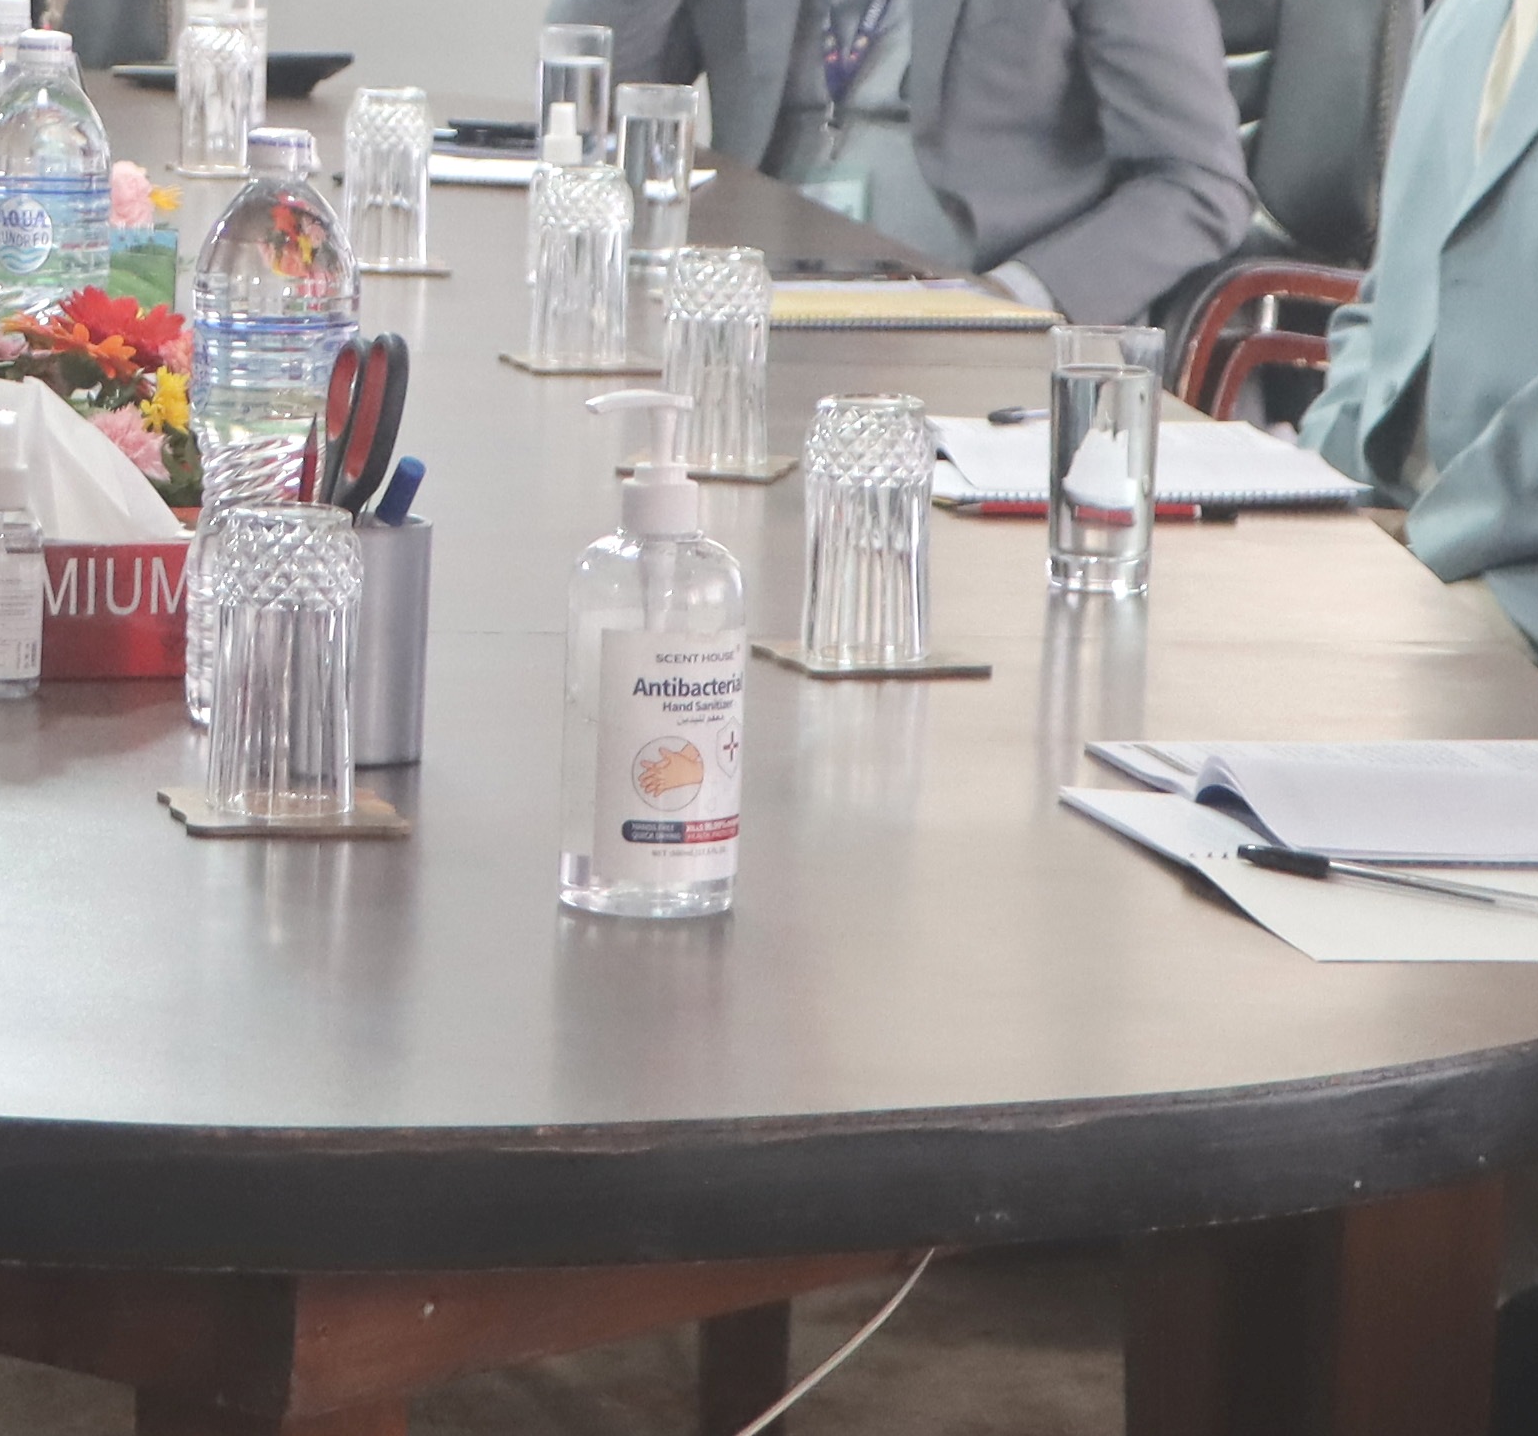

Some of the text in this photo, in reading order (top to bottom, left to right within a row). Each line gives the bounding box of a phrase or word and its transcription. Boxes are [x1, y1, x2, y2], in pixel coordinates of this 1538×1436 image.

[655, 651, 734, 664] SCENT HOUSE
[632, 671, 744, 697] Antibacterial
[662, 701, 693, 712] Hand
